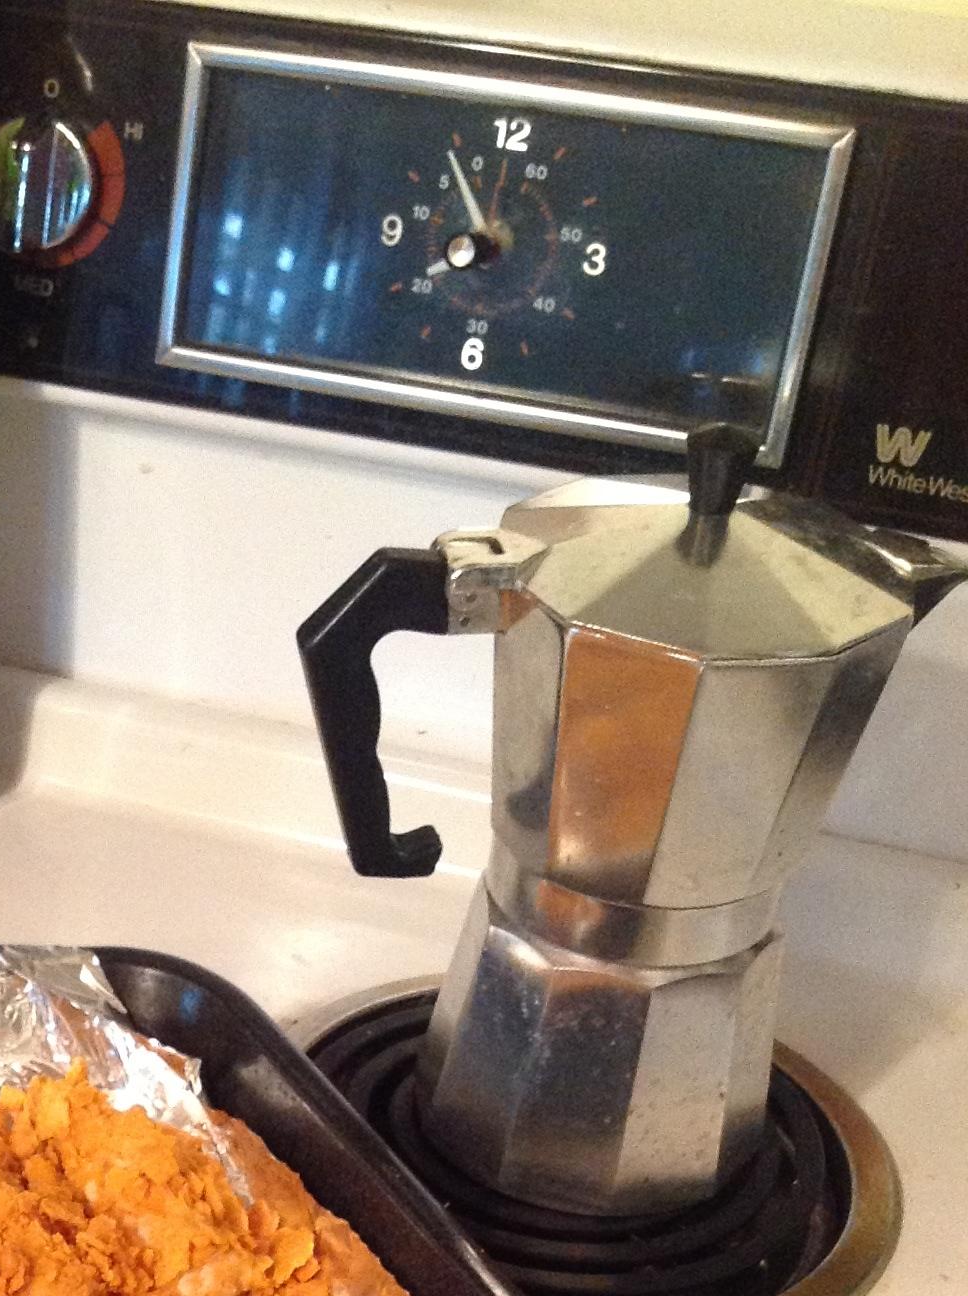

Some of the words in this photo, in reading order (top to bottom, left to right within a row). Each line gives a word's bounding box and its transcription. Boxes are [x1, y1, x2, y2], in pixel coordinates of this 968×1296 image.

[493, 116, 532, 152] 12
[525, 162, 549, 180] 60
[438, 174, 450, 190] 5
[412, 204, 430, 221] 10
[381, 213, 404, 247] 9
[560, 226, 583, 242] 50
[582, 243, 607, 276] 3
[411, 278, 433, 294] 20
[533, 297, 556, 313] 40
[466, 319, 488, 335] 30
[460, 337, 484, 371] 6
[876, 423, 932, 468] W
